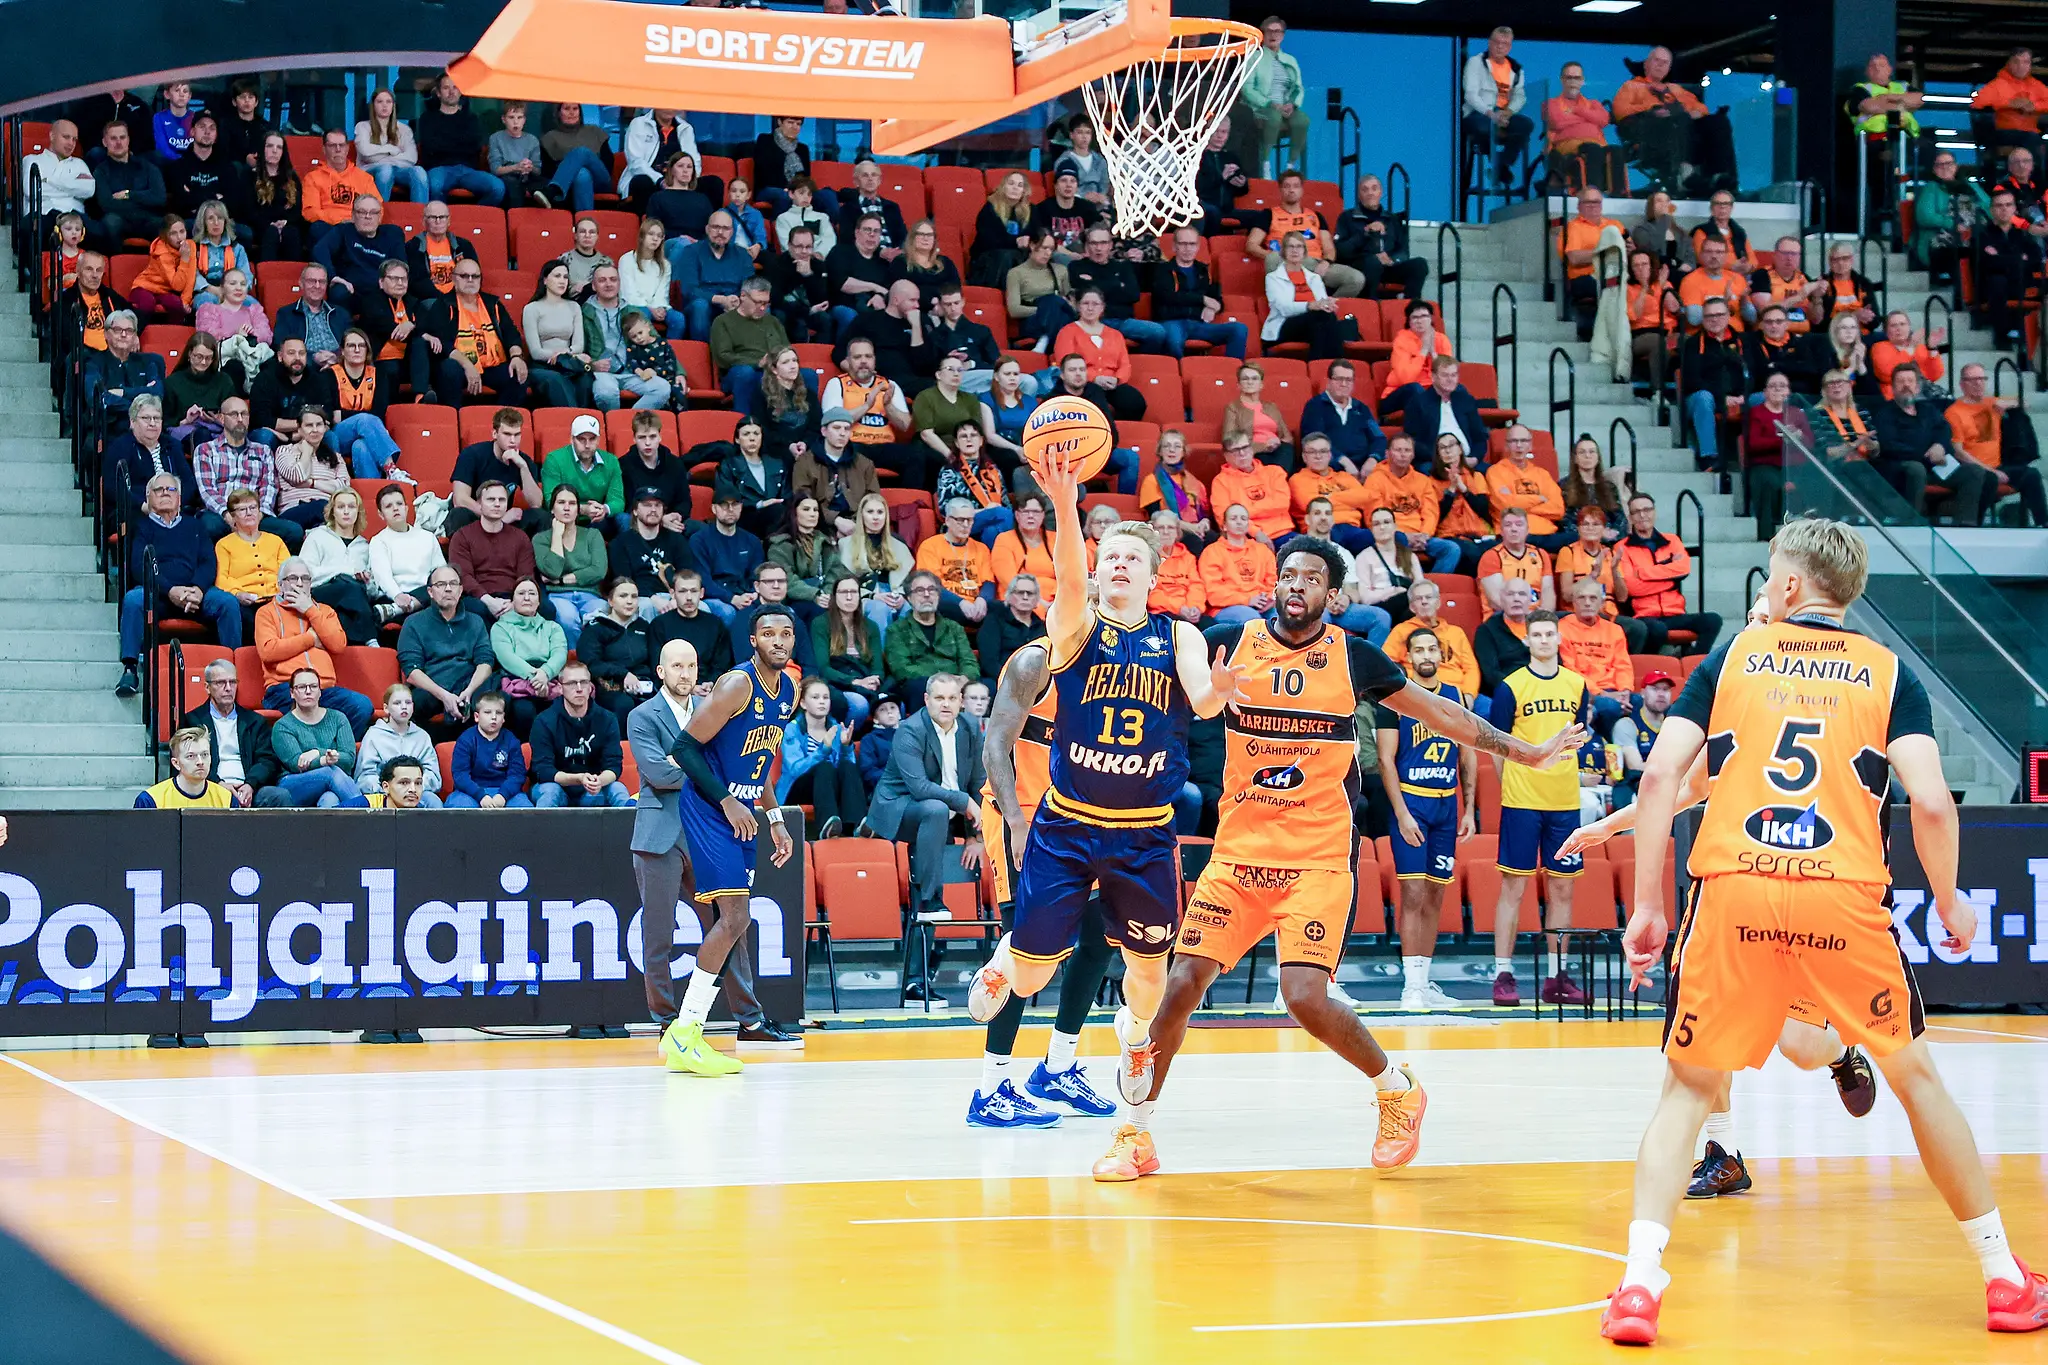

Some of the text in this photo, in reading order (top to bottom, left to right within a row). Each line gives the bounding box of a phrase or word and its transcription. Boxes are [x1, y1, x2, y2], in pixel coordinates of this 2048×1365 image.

[645, 24, 924, 73] SPORT SYSTEM
[1031, 409, 1088, 431] Wilson
[1268, 667, 1305, 697] 10
[1745, 653, 1871, 688] SAJANTILA
[1081, 662, 1173, 716] HELSINKI
[1523, 699, 1578, 717] GULLS
[1097, 706, 1145, 746] 13
[1239, 713, 1336, 734] KARHUBASKET
[1069, 741, 1167, 779] UKKO.fi
[1260, 744, 1321, 756] LÄHITAPIOLA
[1423, 742, 1451, 763] 47
[1762, 716, 1826, 797] 5
[751, 755, 767, 780] 3
[1737, 851, 1836, 880] serres
[1736, 925, 1847, 952] Terveystalo
[1674, 1011, 1698, 1048] 5
